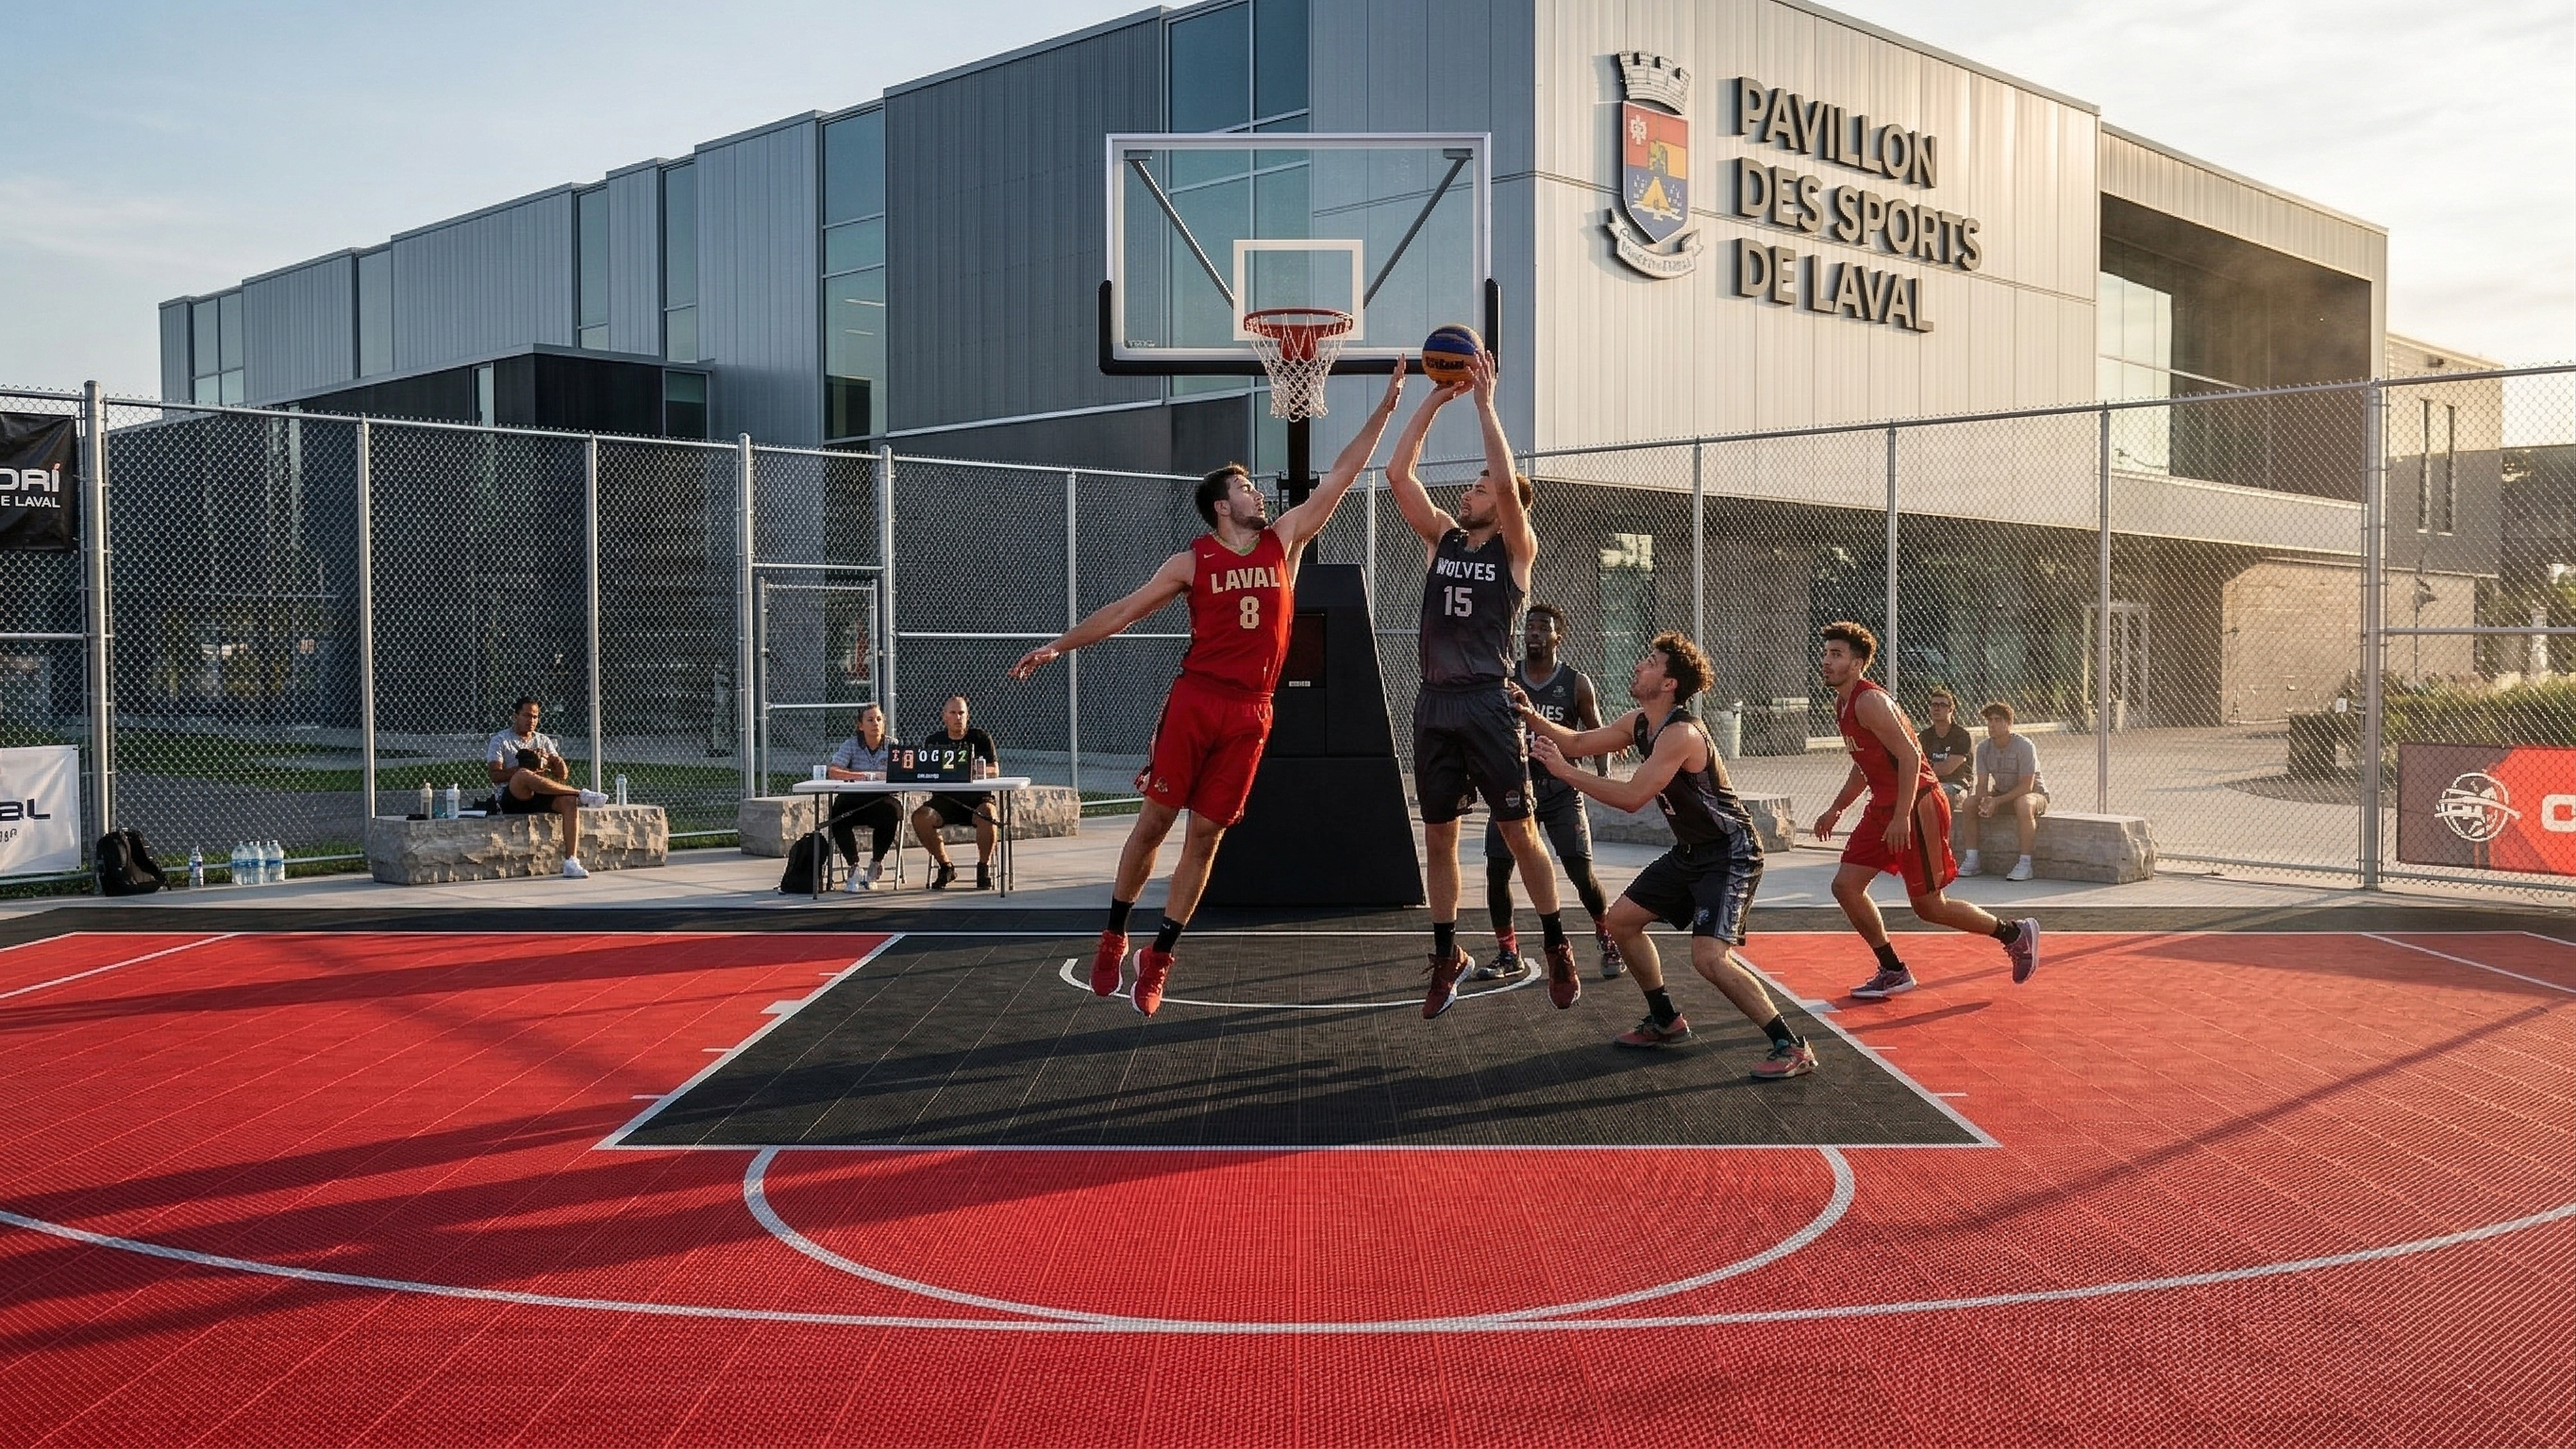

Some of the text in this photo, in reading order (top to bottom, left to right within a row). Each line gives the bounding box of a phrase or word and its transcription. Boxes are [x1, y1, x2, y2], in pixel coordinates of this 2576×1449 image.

[1738, 76, 1937, 189] PAVILLON
[1738, 157, 1982, 271] DES SPORTS
[1738, 238, 1798, 306] DE
[1808, 254, 1934, 332] LAVAL
[14, 495, 61, 508] LAVAL
[1211, 567, 1280, 594] LAVAL
[1436, 557, 1496, 582] WOLVES
[1239, 595, 1260, 629] 8
[1444, 585, 1472, 617] 15
